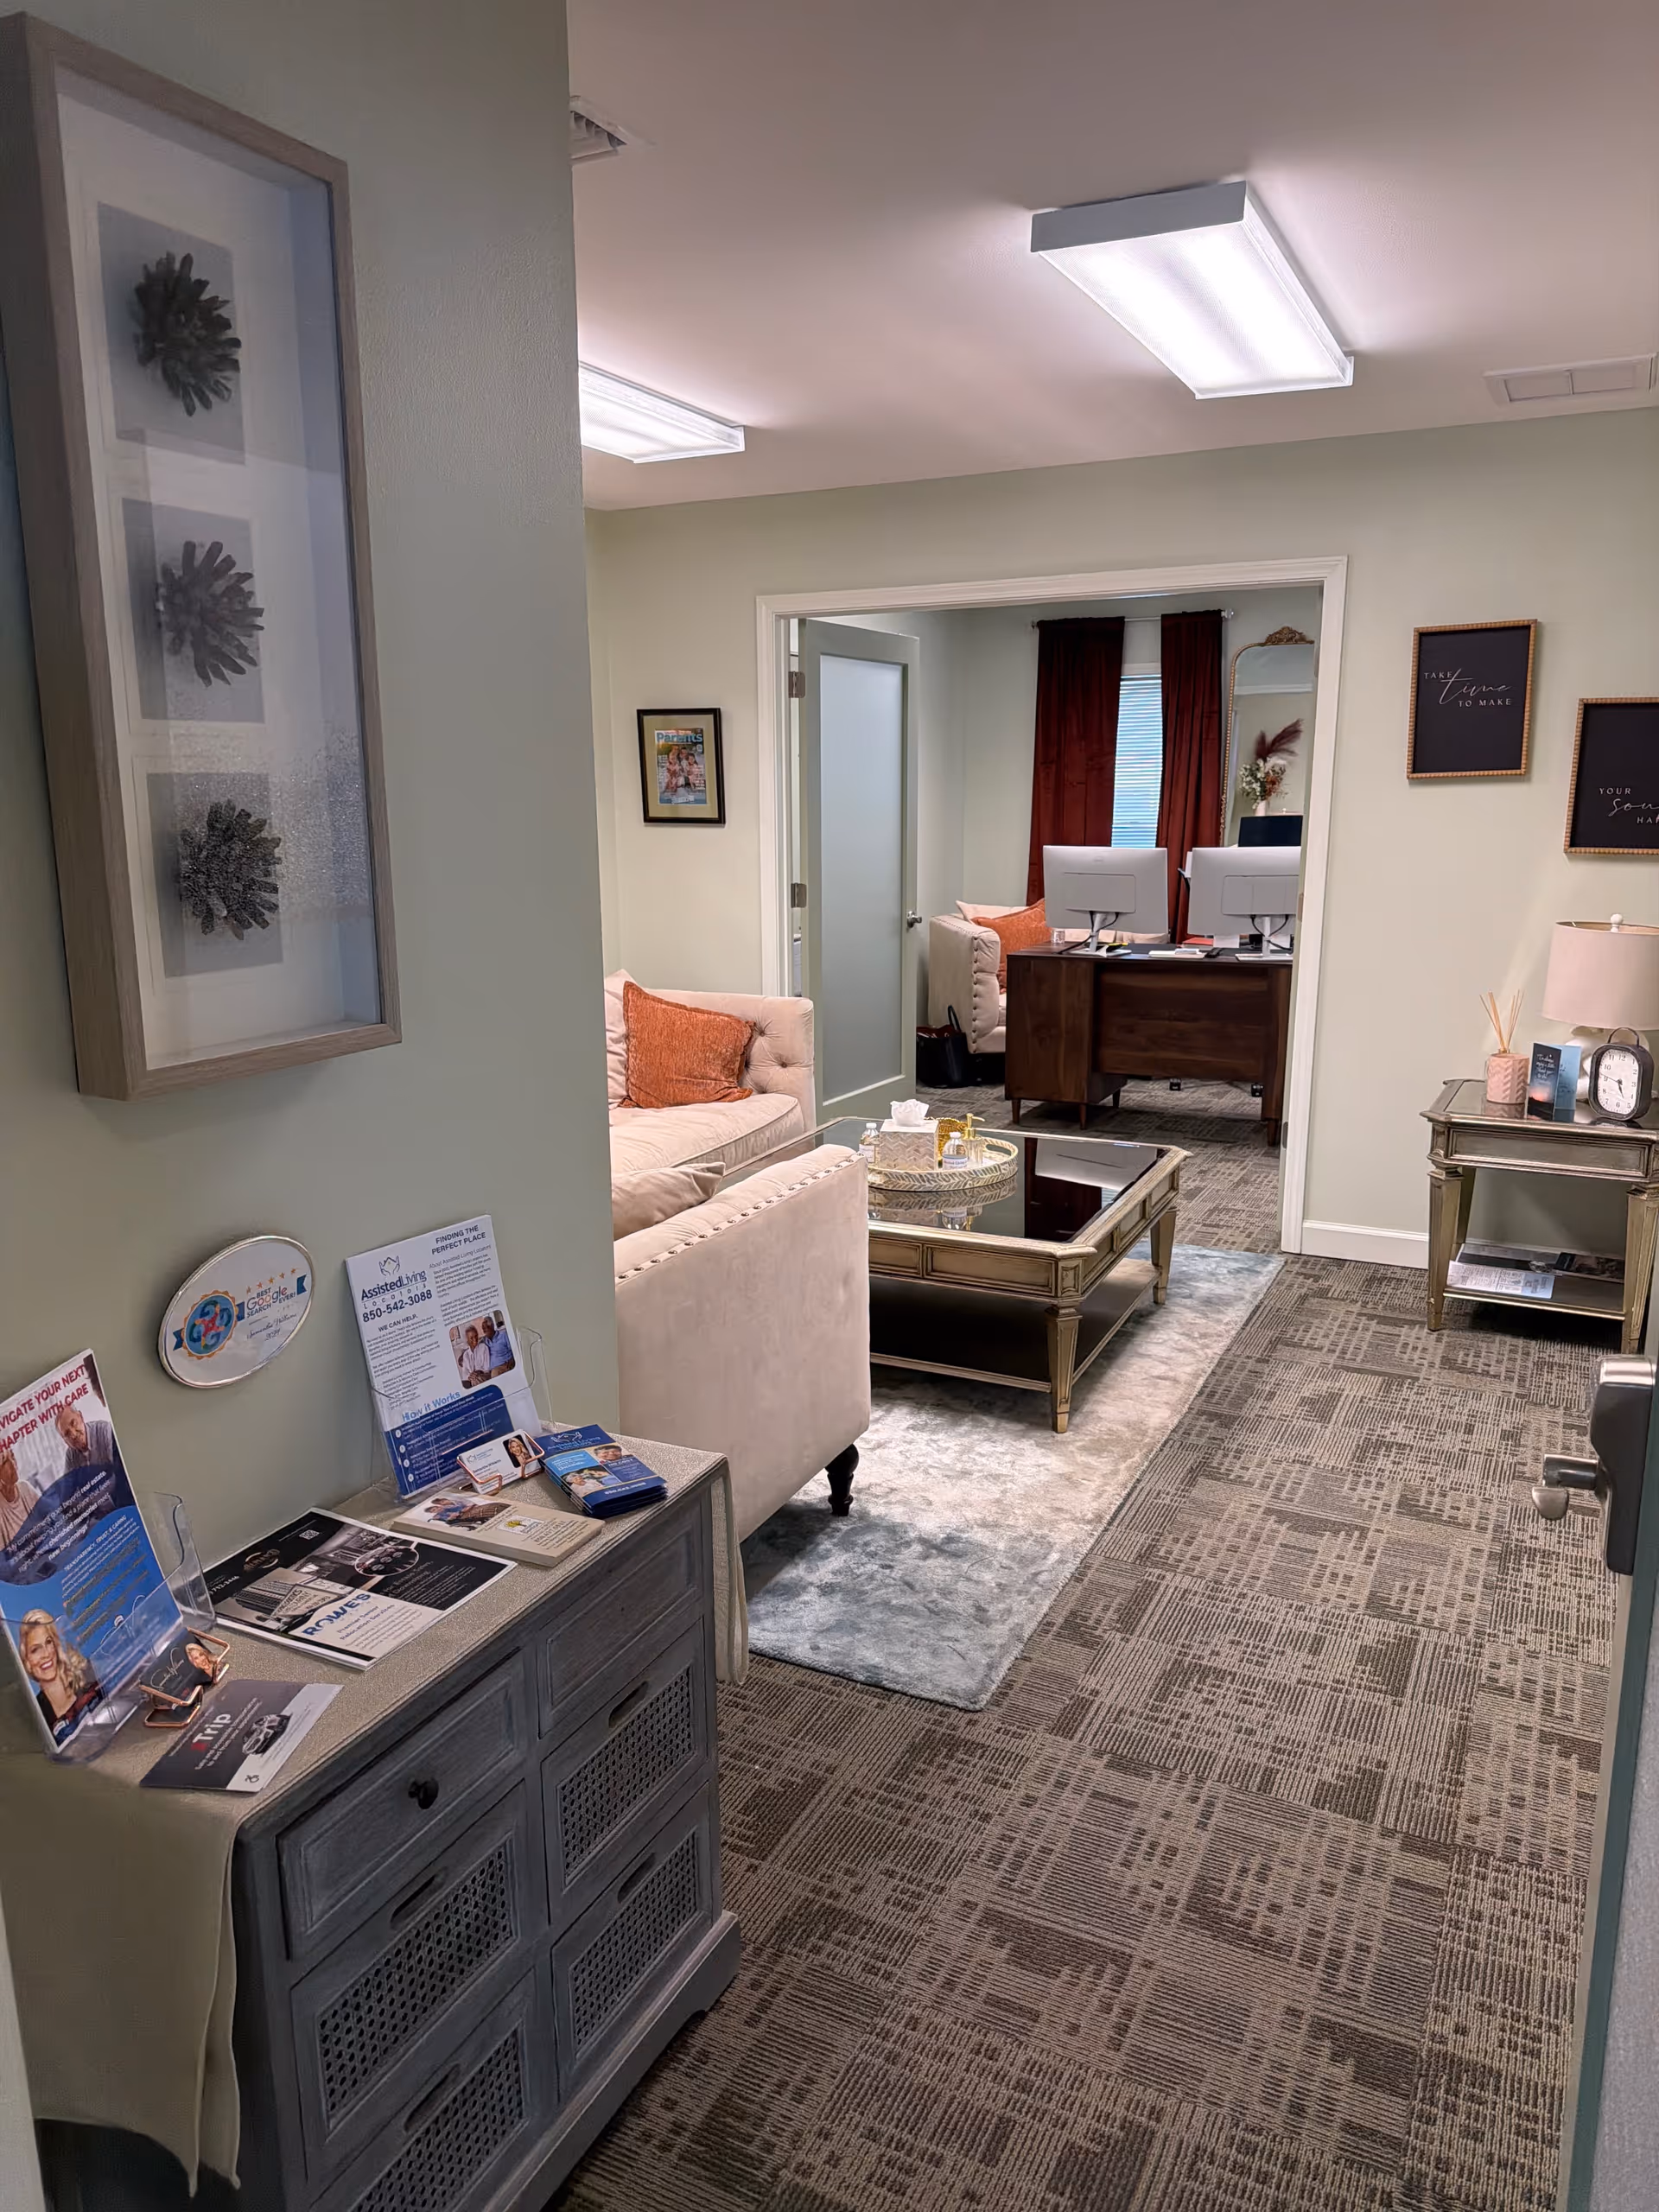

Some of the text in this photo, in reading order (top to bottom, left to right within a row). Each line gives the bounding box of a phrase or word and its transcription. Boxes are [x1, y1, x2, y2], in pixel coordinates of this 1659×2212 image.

[1424, 671, 1452, 679] TAKE
[1439, 668, 1512, 704] time
[1478, 698, 1512, 707] MAKE
[431, 1231, 486, 1255] PERFECT PLACE
[435, 1224, 480, 1244] FINDING THE
[246, 1286, 288, 1310] Google
[246, 1291, 296, 1319] SEARCH EVER!
[256, 1287, 272, 1299] BEST
[363, 1289, 433, 1323] 850-542-3088
[388, 1319, 401, 1328] CAN
[0, 1363, 86, 1432] VIGATE YOUR NEXT
[37, 1401, 65, 1424] WITH
[64, 1382, 89, 1407] CARE
[402, 1391, 461, 1422] How it Works
[61, 1491, 81, 1510] beyond
[80, 1481, 91, 1494] real
[48, 1522, 73, 1546] cherished
[73, 1503, 99, 1526] memories
[48, 1548, 60, 1560] new
